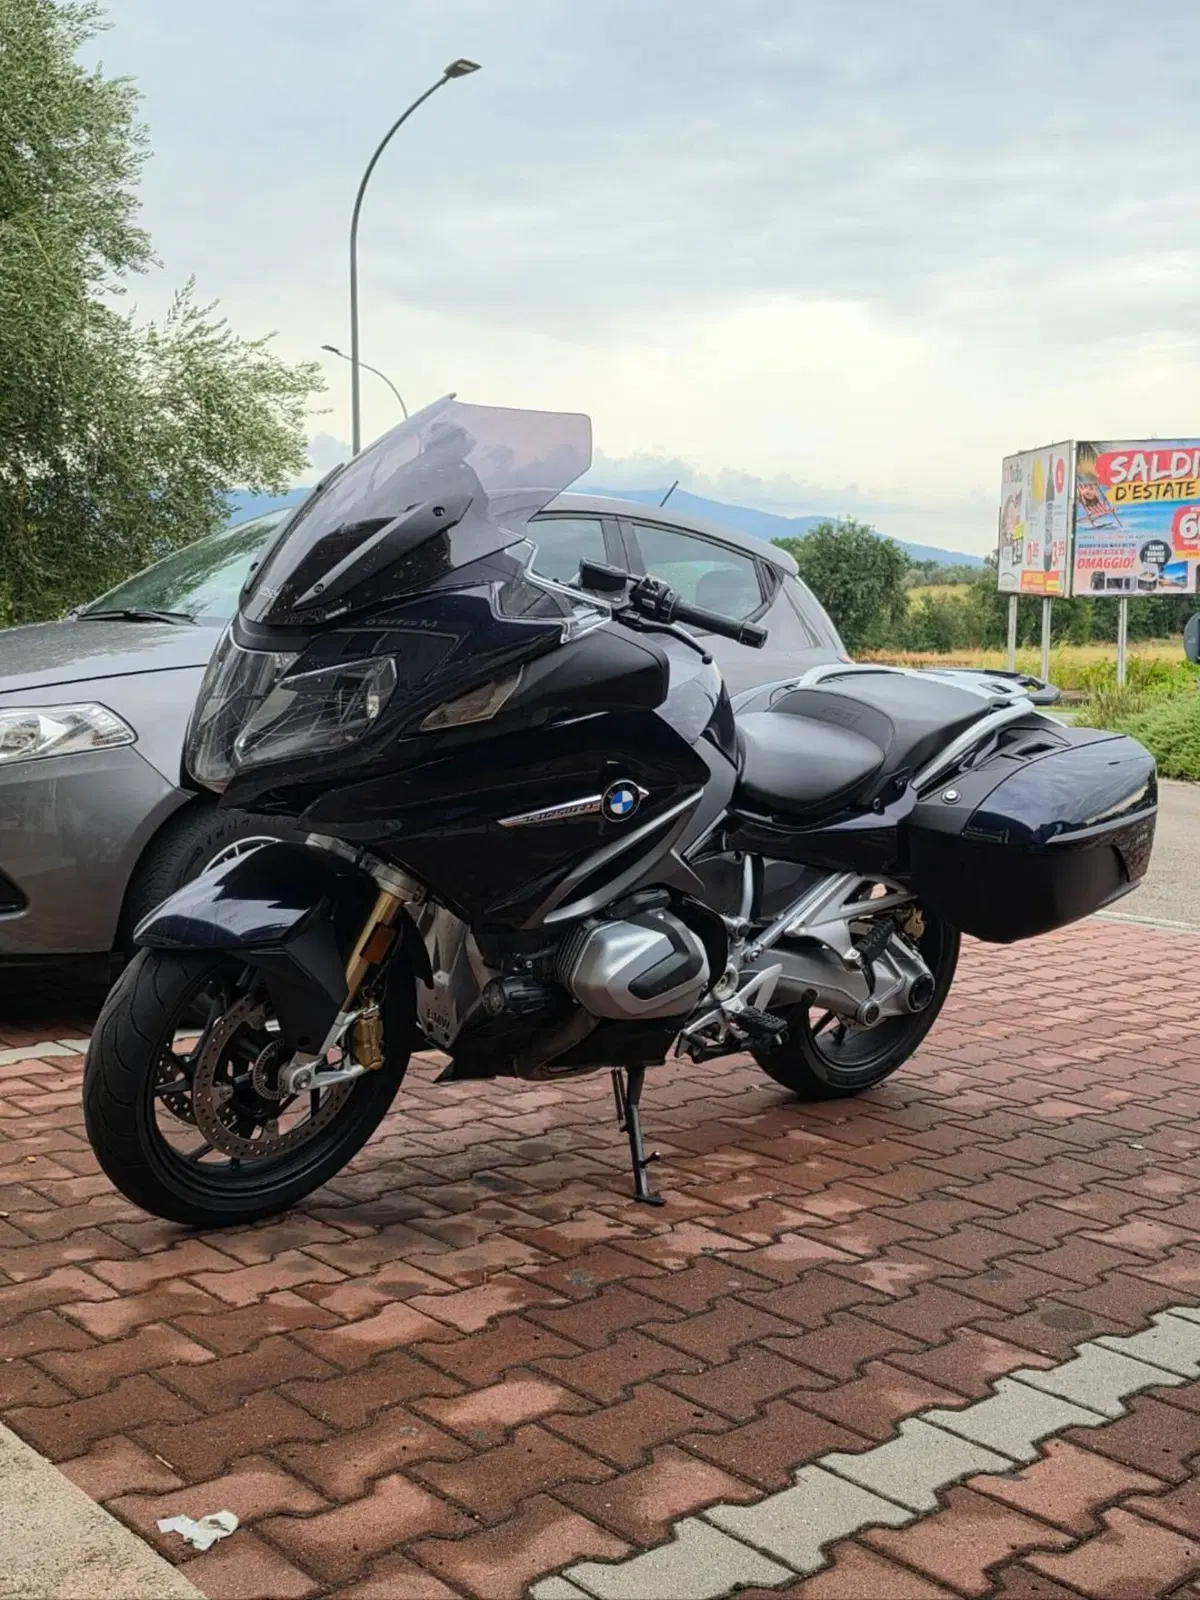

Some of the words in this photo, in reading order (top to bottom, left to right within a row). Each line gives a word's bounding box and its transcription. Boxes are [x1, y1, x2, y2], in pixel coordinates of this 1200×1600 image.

[1110, 451, 1200, 485] SALDI
[1115, 480, 1196, 501] D'ESTATE
[1077, 557, 1135, 569] OMAGGIO!
